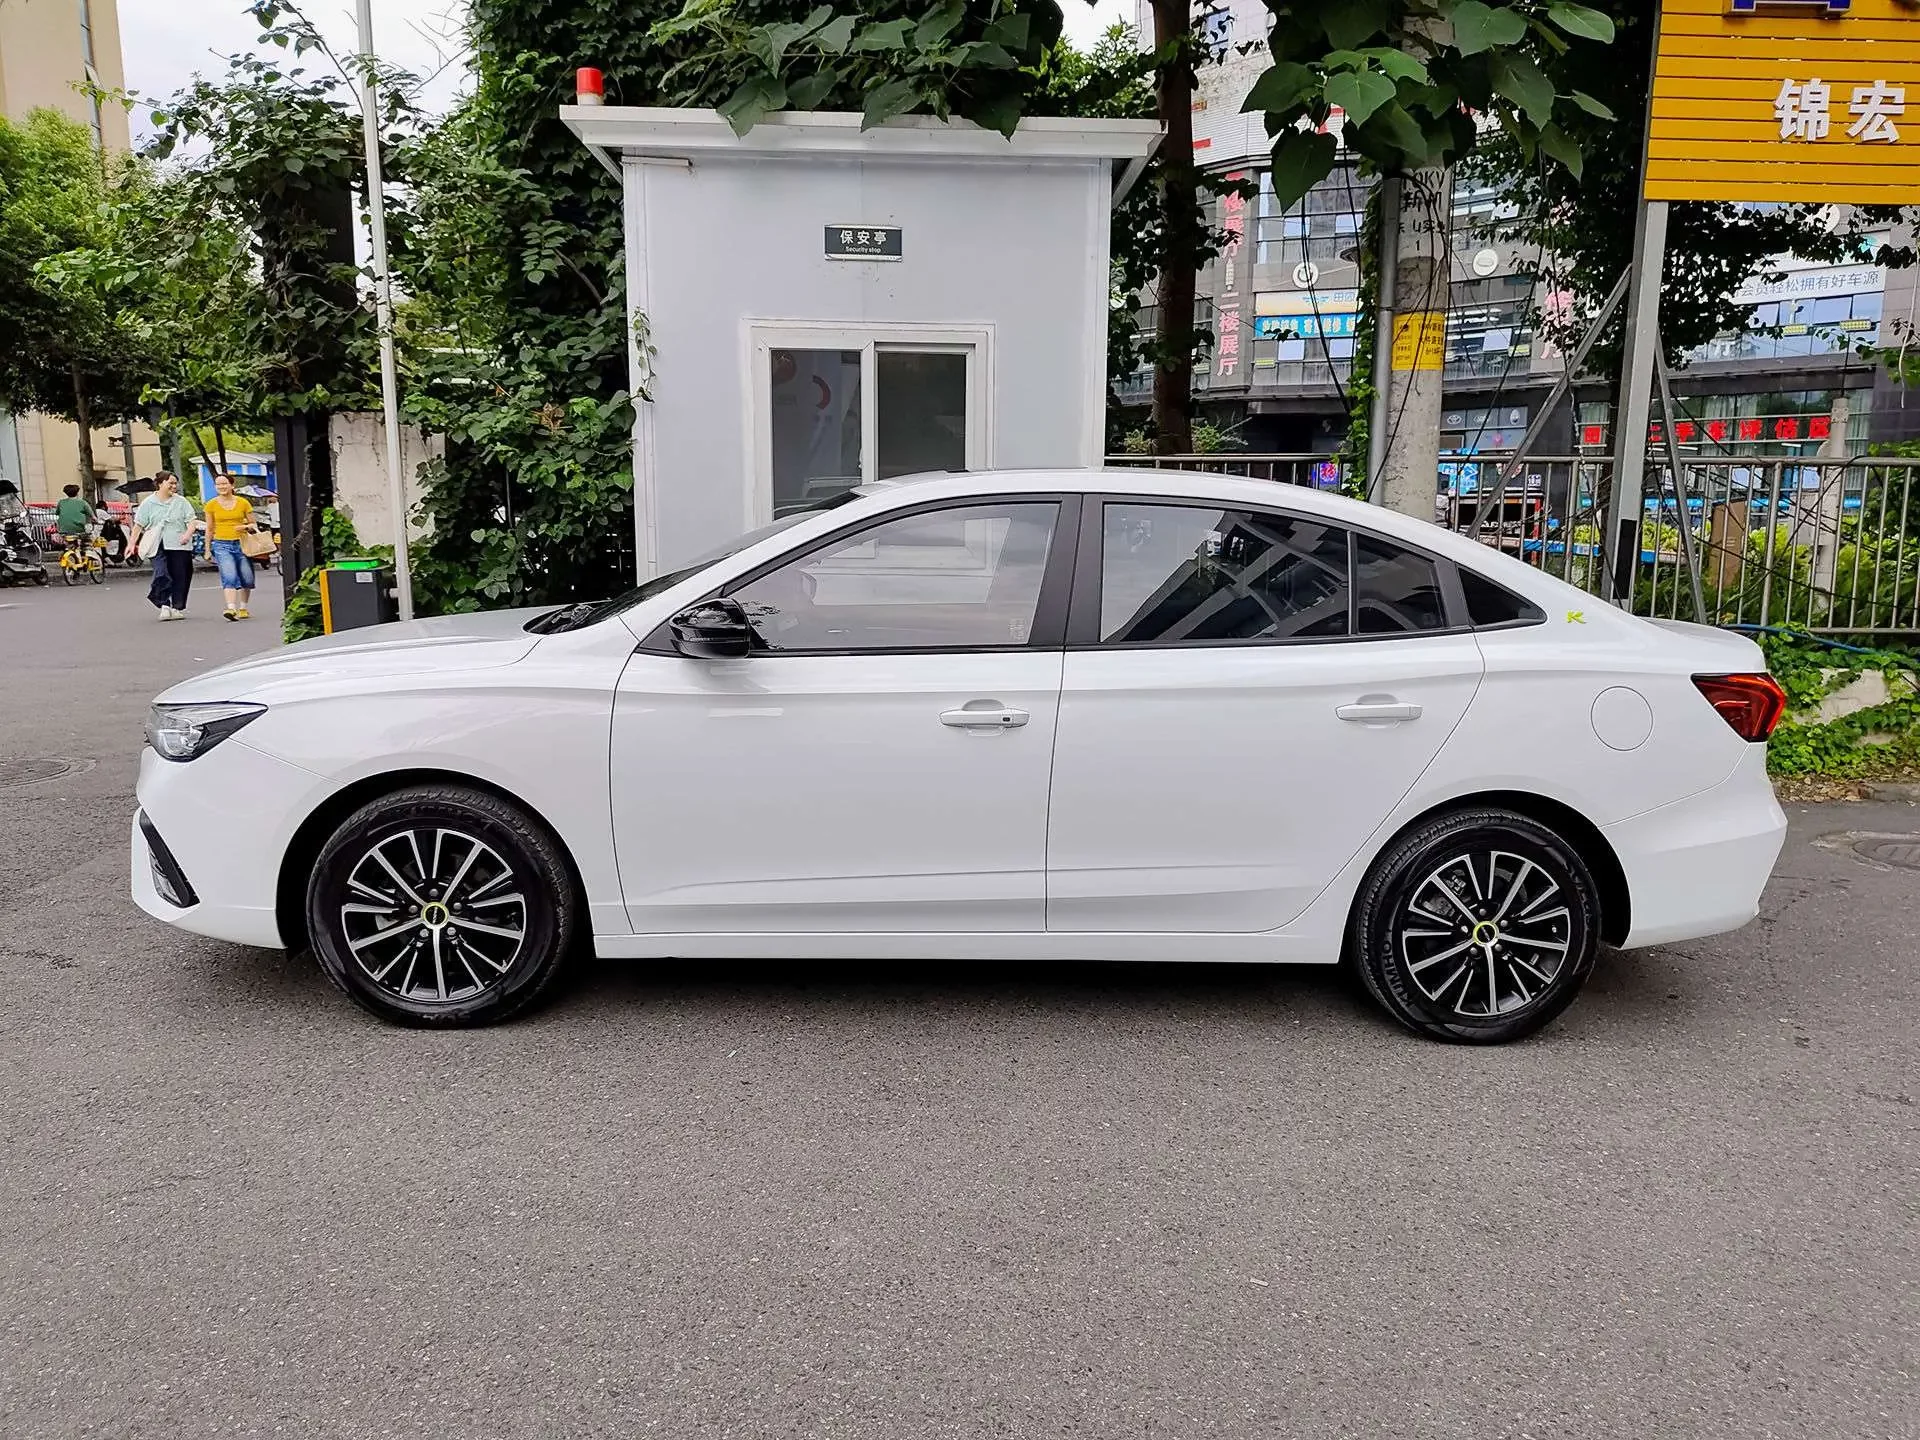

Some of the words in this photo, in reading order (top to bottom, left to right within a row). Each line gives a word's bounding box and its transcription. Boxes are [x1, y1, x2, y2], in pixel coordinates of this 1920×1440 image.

[1773, 77, 1906, 144] 锦宏
[839, 229, 887, 245] 保安亭
[845, 246, 868, 254] Security
[1736, 270, 1880, 298] 会员轻松拥有好车源
